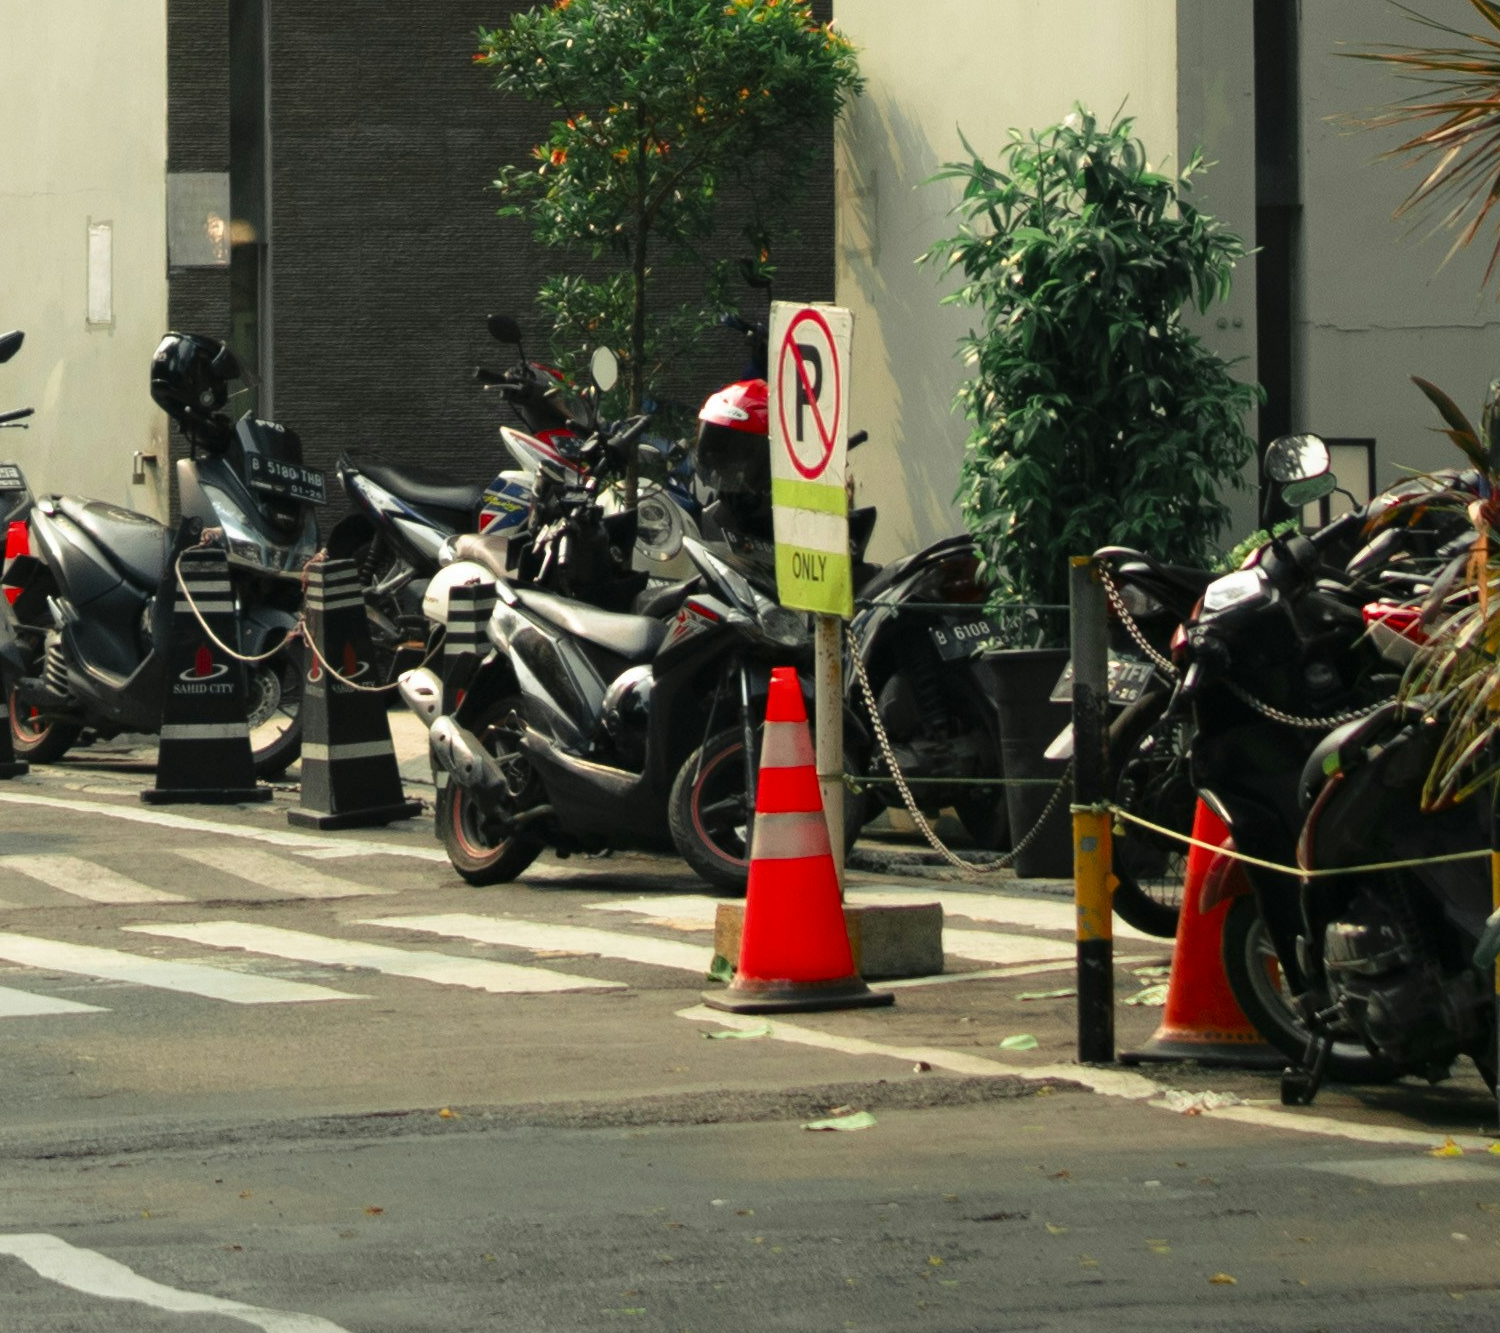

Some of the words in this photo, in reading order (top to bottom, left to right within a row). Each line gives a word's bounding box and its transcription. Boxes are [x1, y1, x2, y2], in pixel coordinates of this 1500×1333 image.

[252, 457, 260, 471] B
[267, 461, 299, 480] 5180
[793, 552, 827, 582] ONLY
[935, 630, 947, 645] B
[953, 621, 991, 641] 6108
[173, 683, 207, 694] SAHID
[209, 683, 234, 694] CITY
